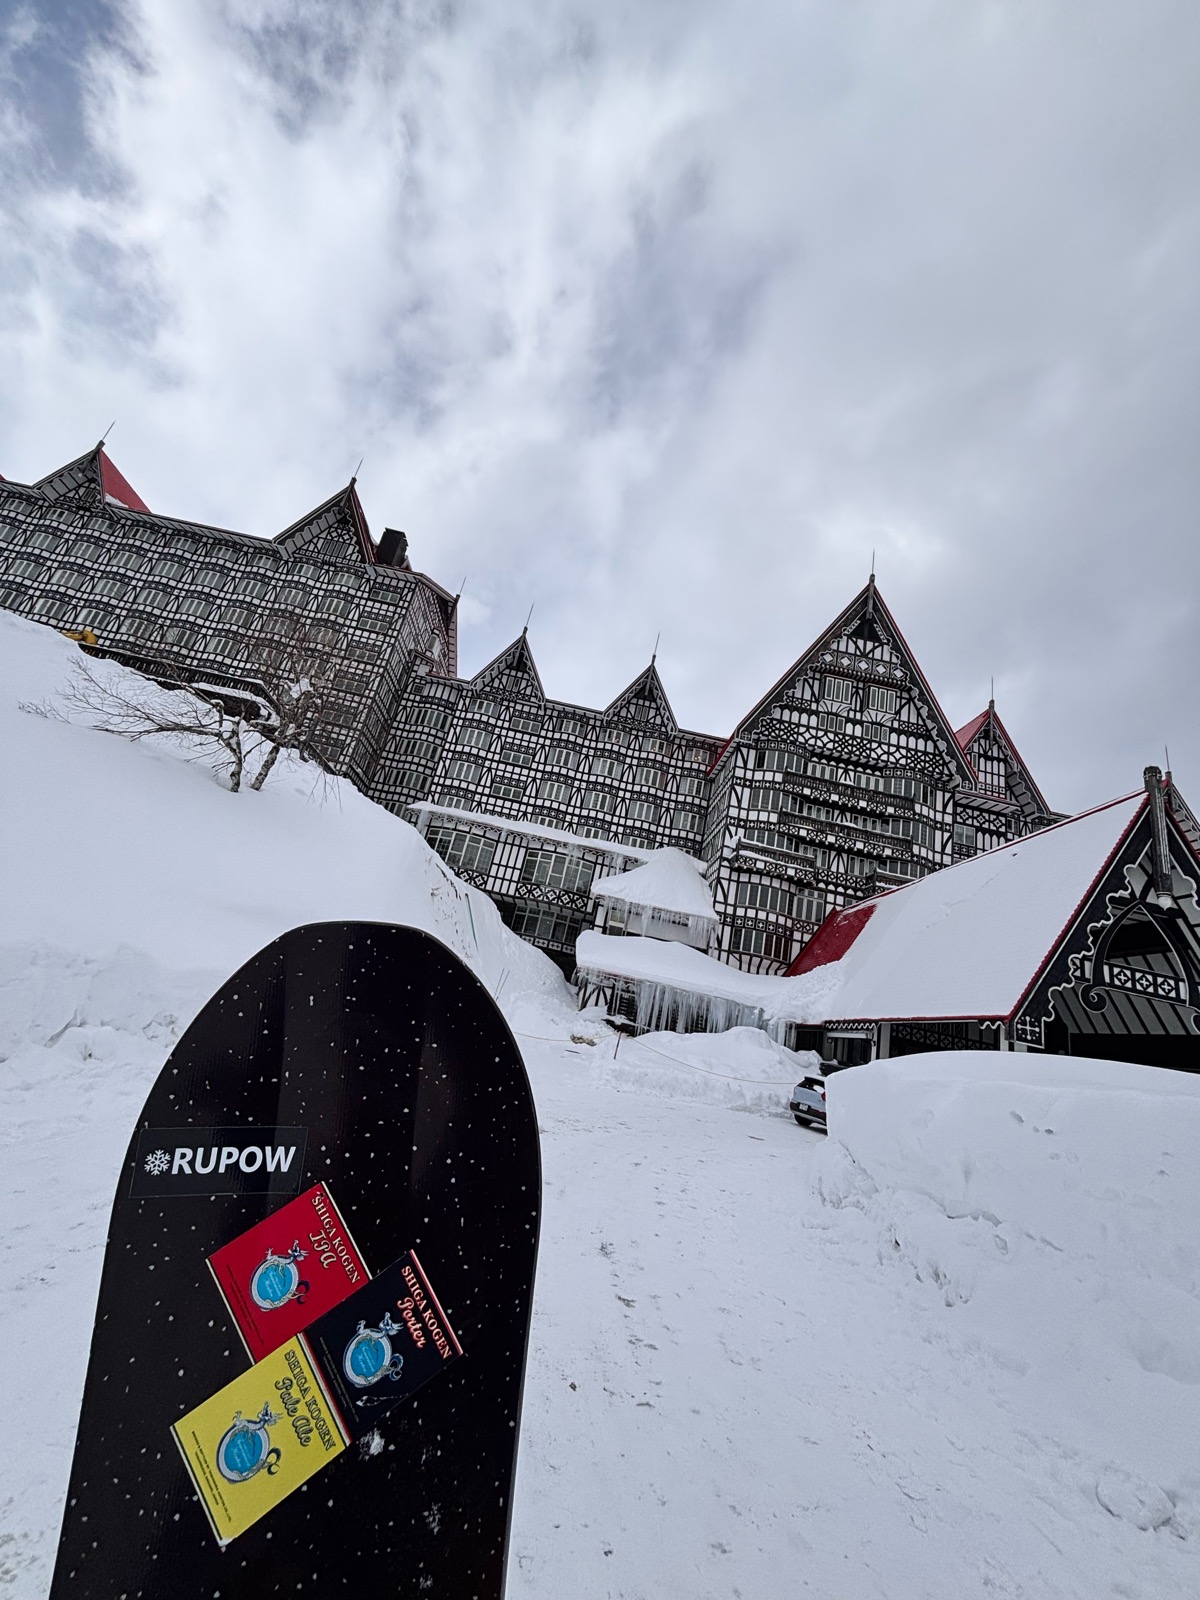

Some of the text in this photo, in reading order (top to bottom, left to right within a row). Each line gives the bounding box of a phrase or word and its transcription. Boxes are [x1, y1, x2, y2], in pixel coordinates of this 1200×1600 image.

[171, 1146, 296, 1174] RUPOW
[311, 1195, 361, 1284] SHIGA KOGEN
[396, 1296, 427, 1349] Porter
[401, 1265, 453, 1360] SHIGA KOGEN
[274, 1376, 315, 1448] Pale Ale
[284, 1349, 312, 1400] SHIGA
[304, 1395, 336, 1452] KOGEN
